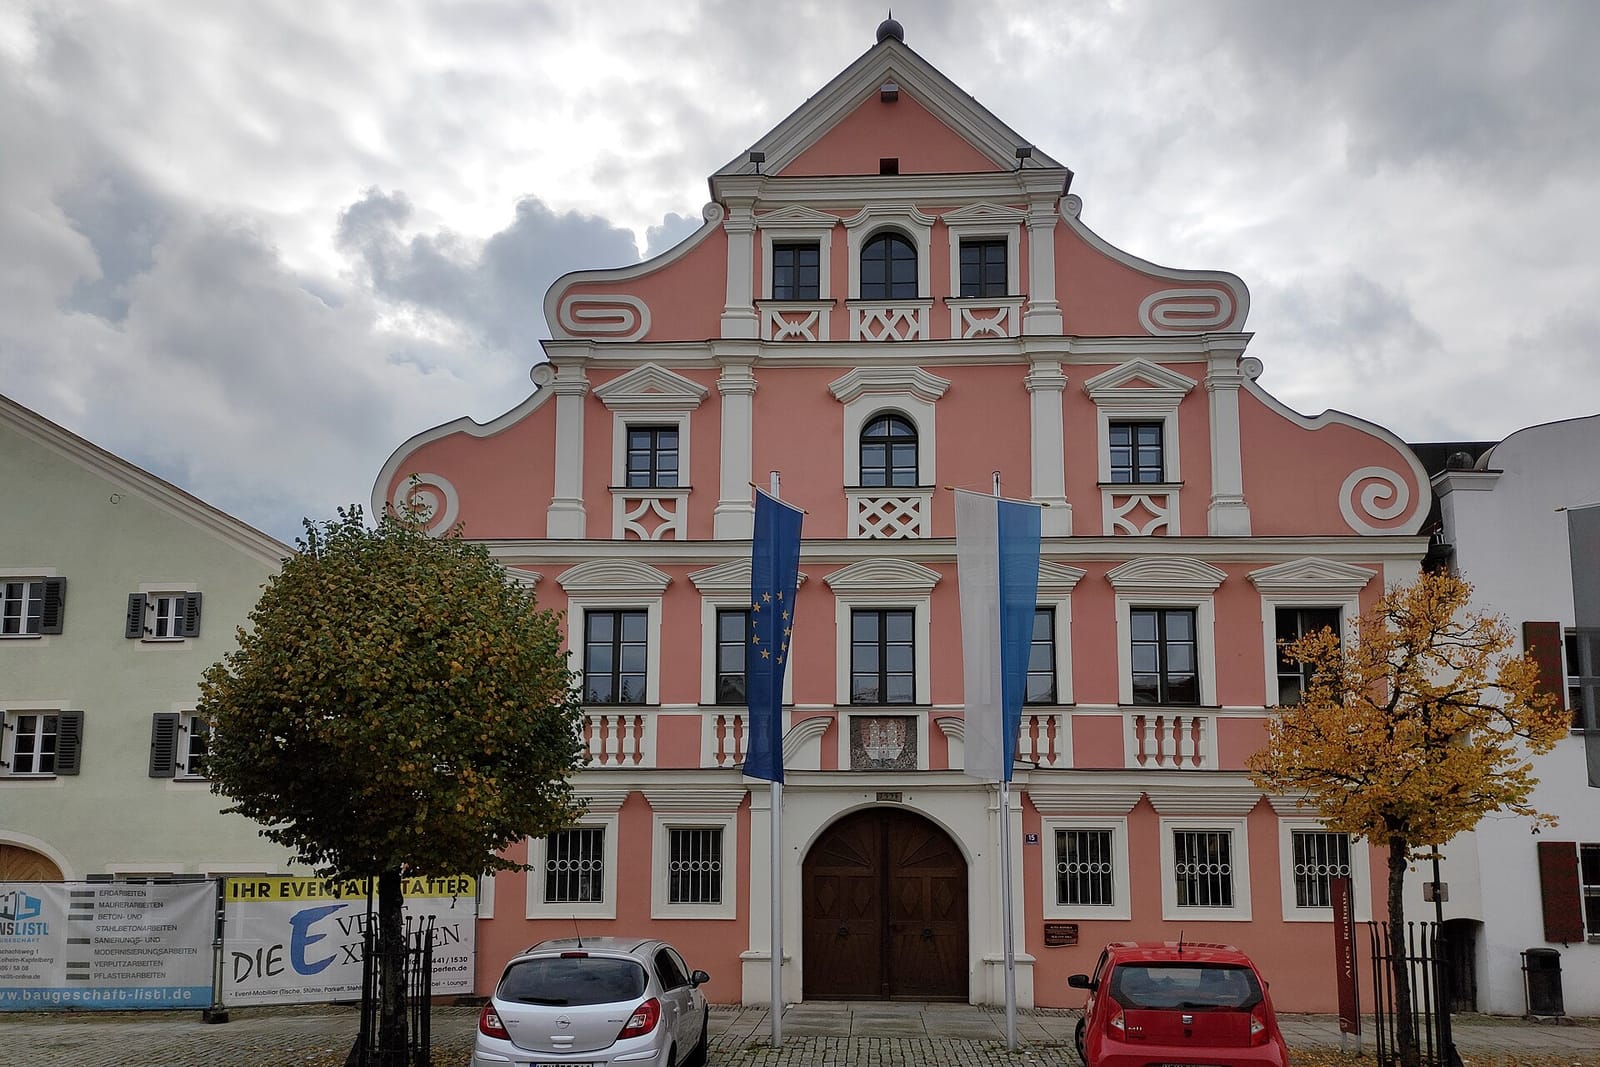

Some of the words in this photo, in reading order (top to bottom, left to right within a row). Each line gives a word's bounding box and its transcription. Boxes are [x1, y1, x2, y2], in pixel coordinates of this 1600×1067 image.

[232, 883, 271, 898] IHR
[279, 879, 470, 898] EVENTAUTATTER
[99, 889, 147, 897] ERDARBEITEN
[98, 901, 164, 909] MAURERARBEITEN
[97, 913, 125, 921] BETON-
[127, 913, 143, 921] UND
[95, 924, 178, 933] STAHLBETONARBEITEN
[144, 936, 161, 944] UND
[94, 947, 198, 956] MODERNISIERUNGSARBEITEN
[94, 960, 164, 968] VERPUTZARBEITEN
[231, 944, 285, 984] DIE
[1344, 945, 1352, 979] Altes
[94, 972, 166, 980] PFLASTERARBEITEN
